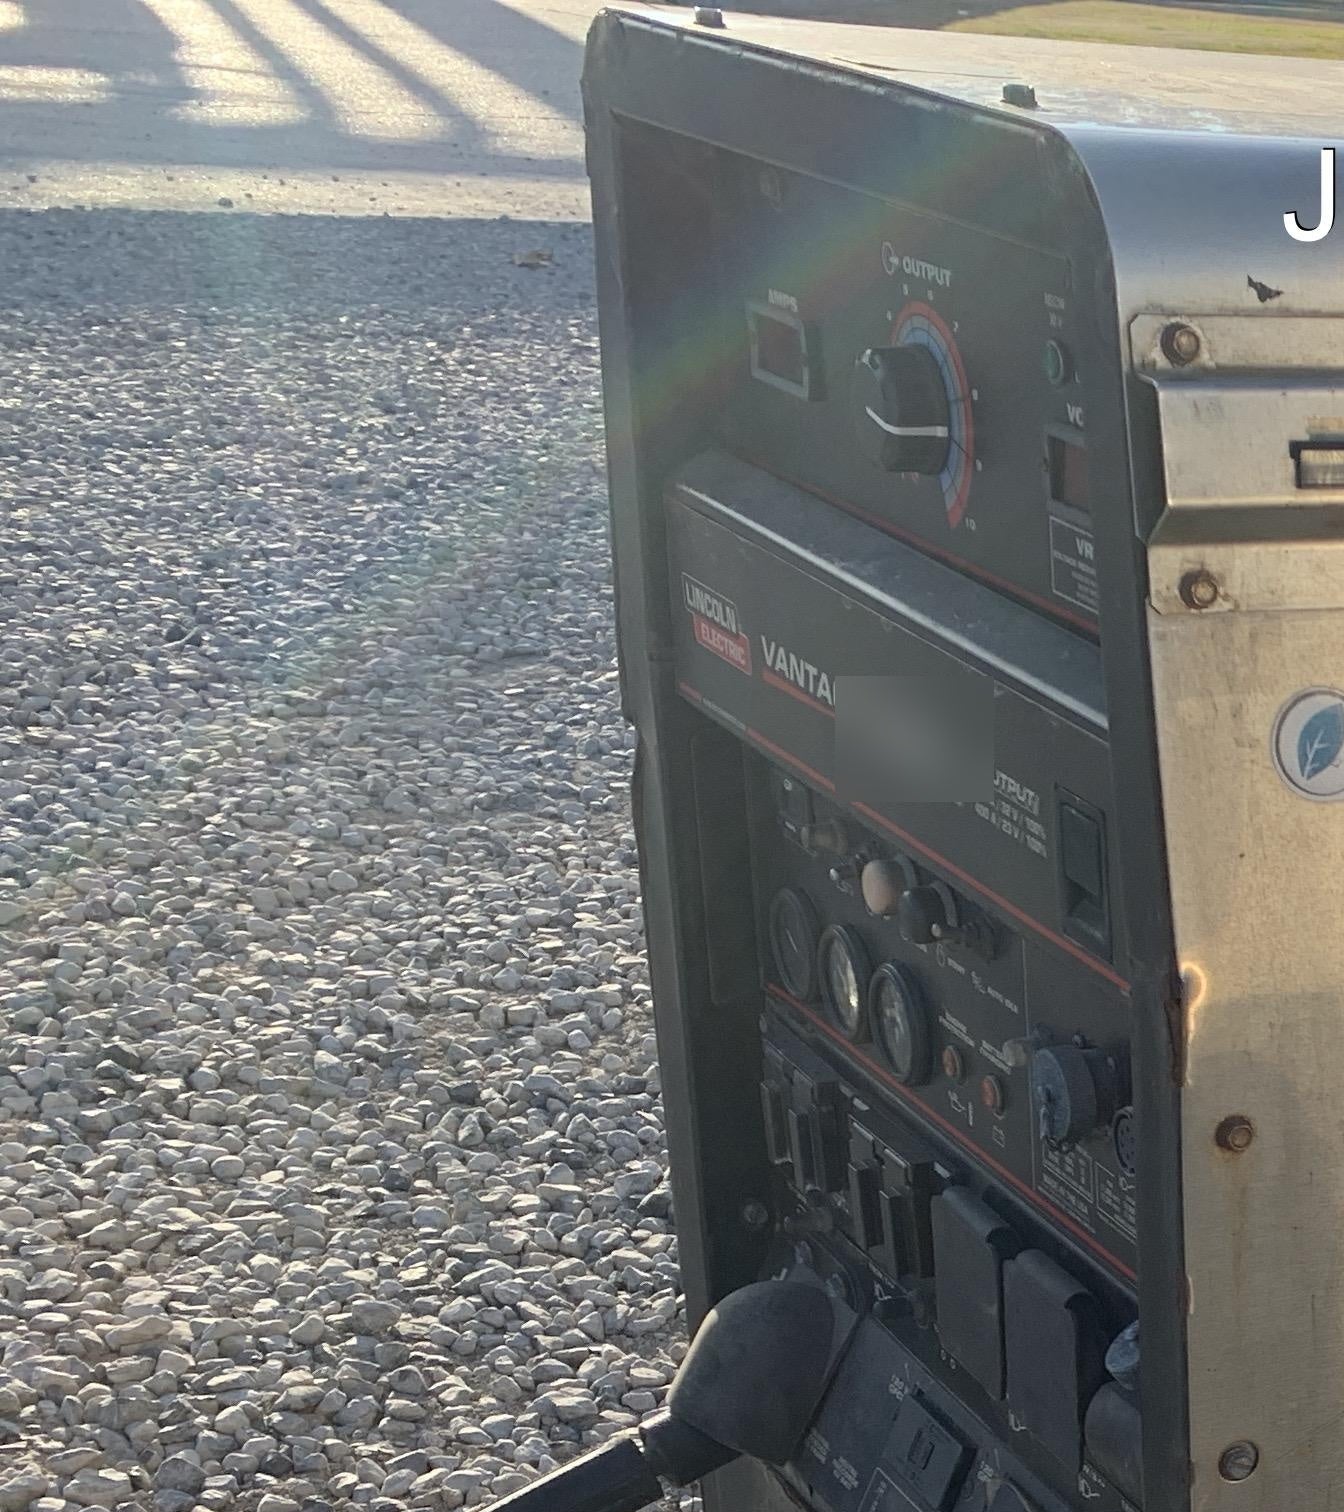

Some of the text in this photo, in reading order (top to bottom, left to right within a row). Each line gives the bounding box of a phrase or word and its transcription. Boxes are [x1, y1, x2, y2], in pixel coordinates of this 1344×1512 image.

[903, 256, 952, 288] OUTPUT
[685, 580, 737, 634] LINCOLN
[701, 621, 746, 667] ELECTRIC
[761, 634, 835, 706] VANTA
